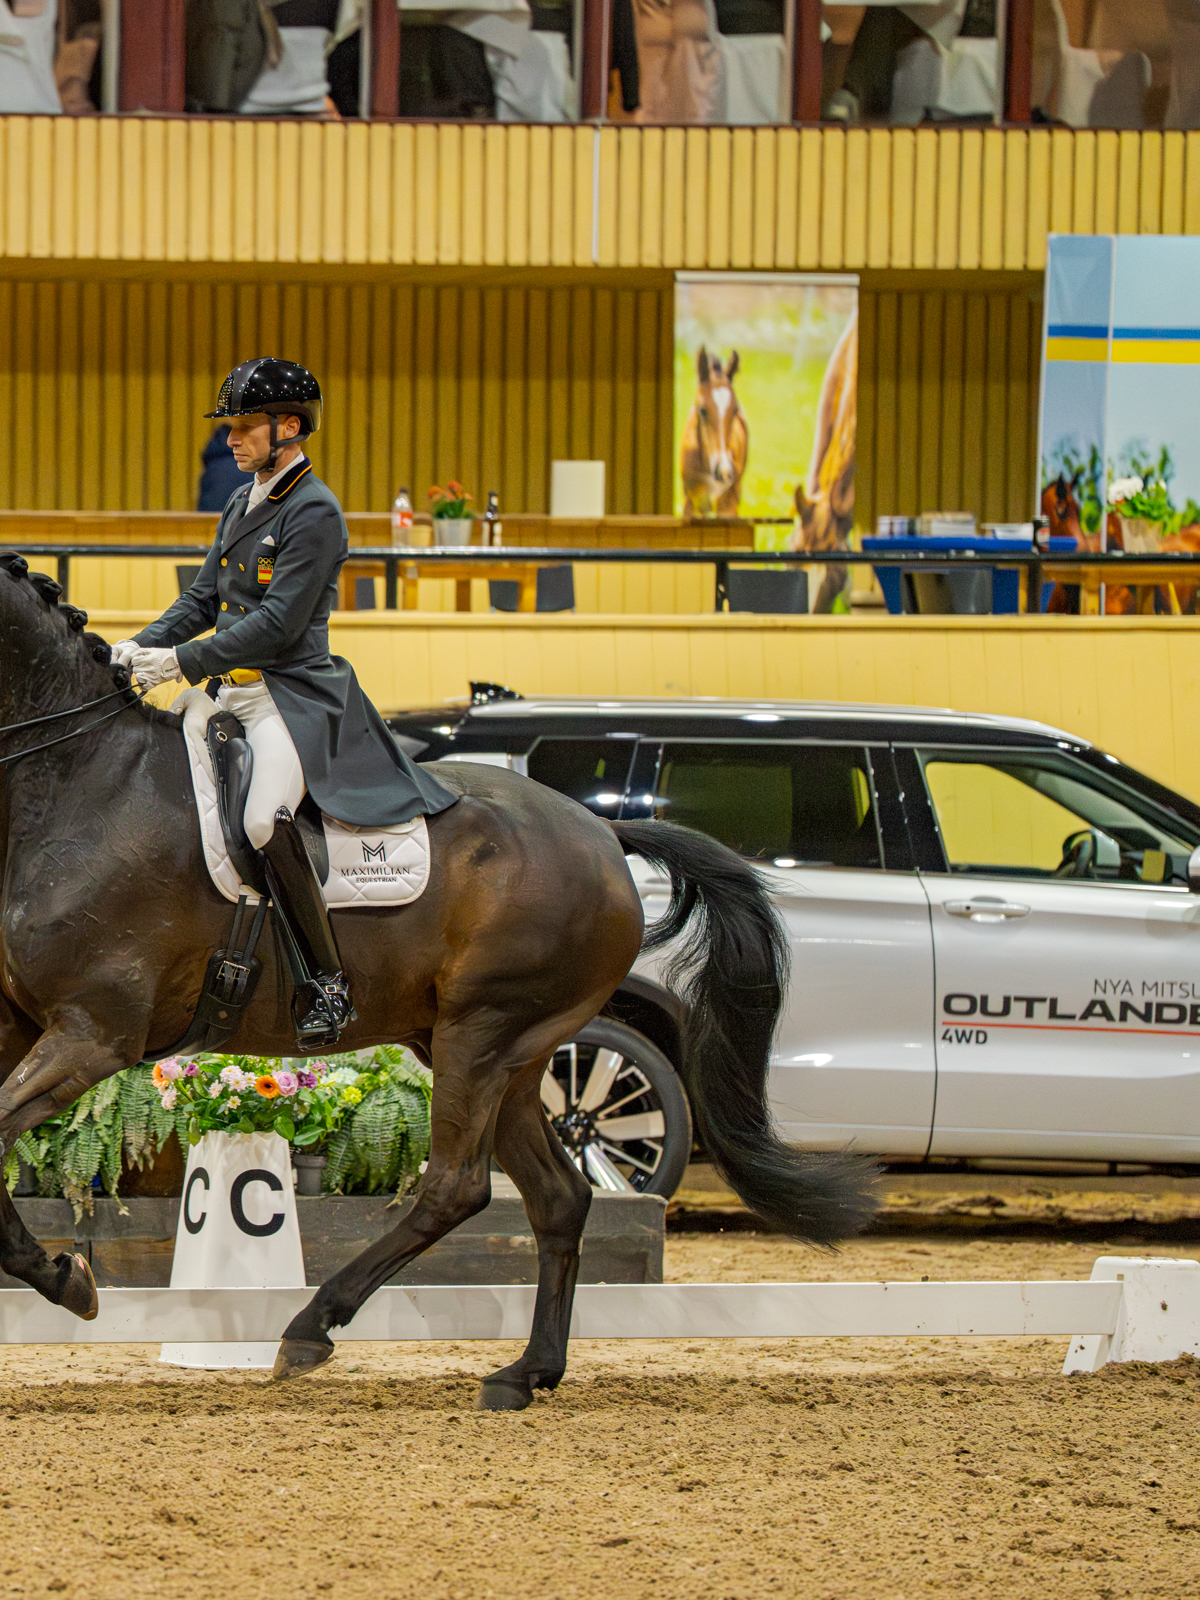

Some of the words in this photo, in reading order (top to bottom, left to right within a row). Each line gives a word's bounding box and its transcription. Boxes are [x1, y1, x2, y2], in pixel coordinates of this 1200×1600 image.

[340, 866, 410, 877] MAXIMILIAN
[1093, 978, 1134, 996] NYA
[941, 1028, 988, 1045] 4WD
[184, 1166, 210, 1235] C
[230, 1168, 286, 1237] C
